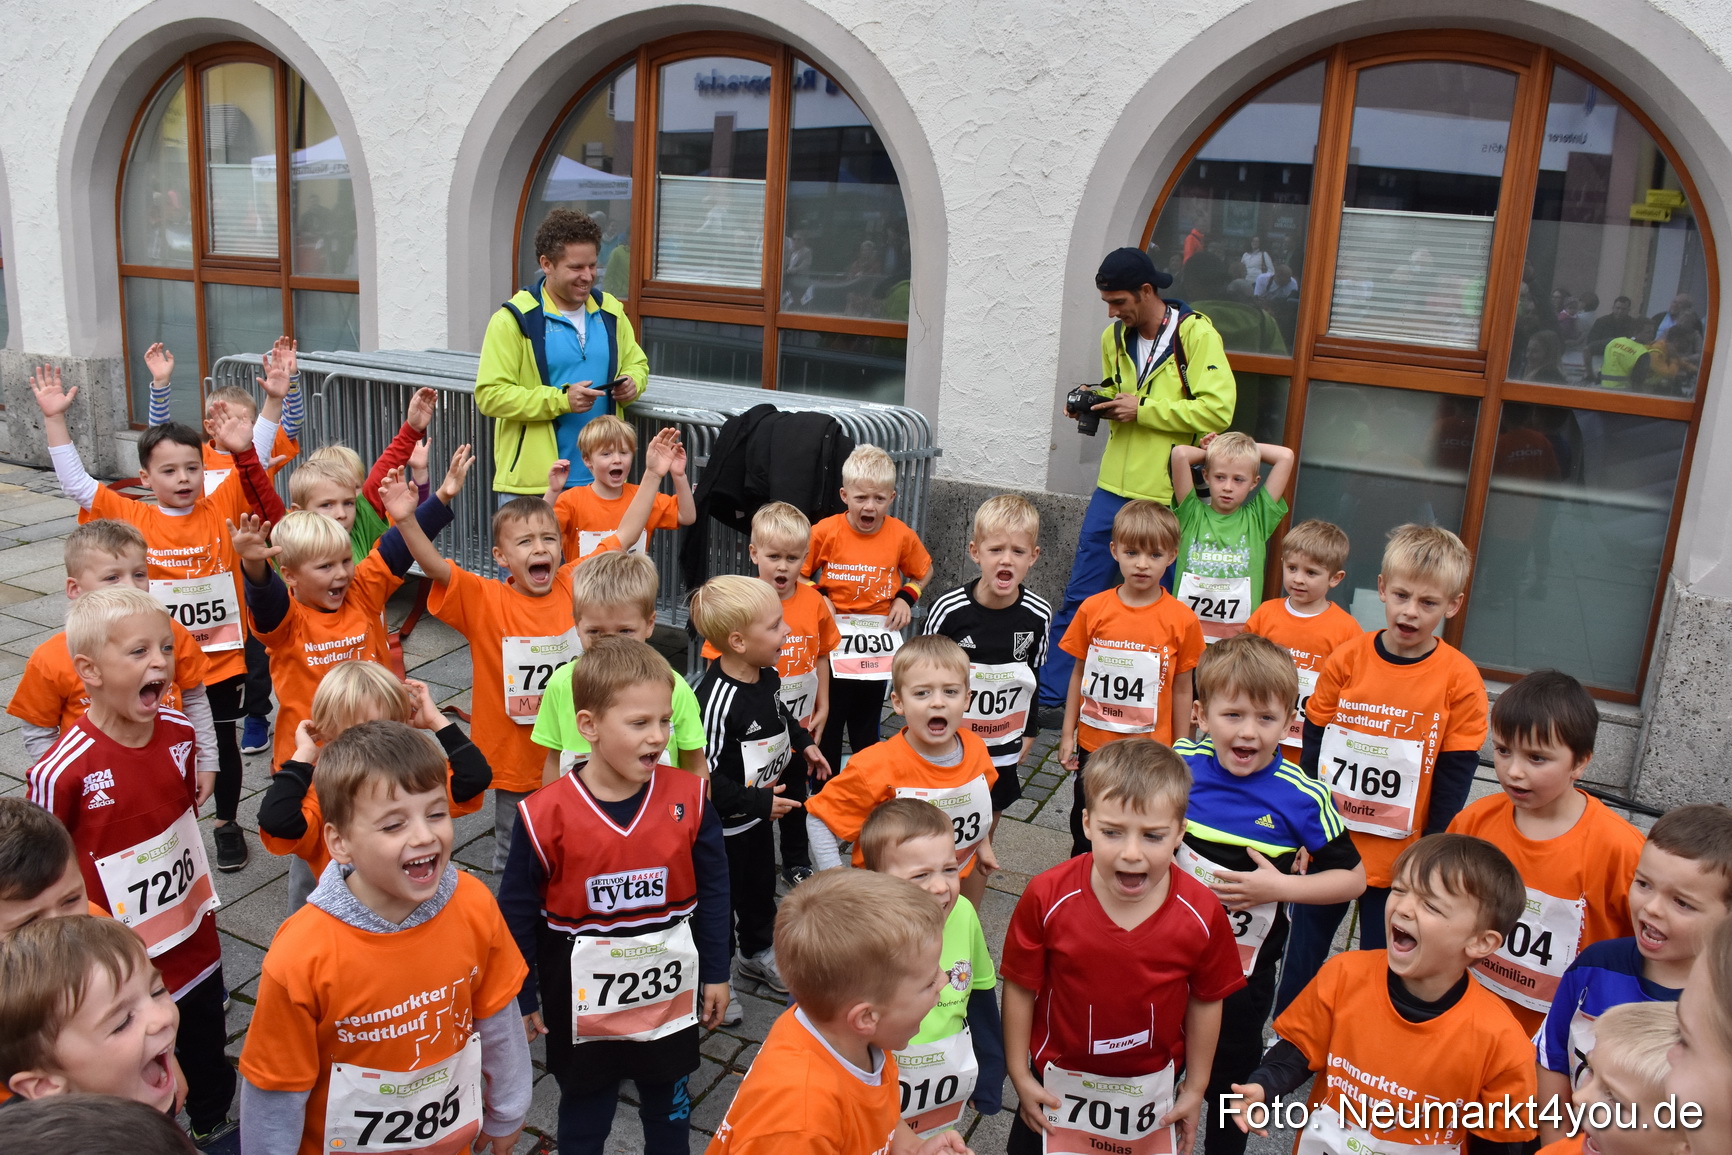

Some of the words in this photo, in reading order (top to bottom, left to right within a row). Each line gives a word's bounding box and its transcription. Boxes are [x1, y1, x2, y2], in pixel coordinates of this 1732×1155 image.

[827, 562, 877, 572] Neumarkter
[1201, 552, 1243, 564] BOCK
[827, 572, 866, 583] Stadtlauf
[166, 599, 227, 627] 7055
[1188, 595, 1241, 619] 7247
[192, 632, 209, 643] ats
[304, 633, 365, 652] Neumarkter
[841, 633, 894, 654] 7030
[1093, 637, 1146, 651] Neumarkter
[307, 648, 354, 666] Stadtlauf
[860, 661, 879, 669] Elias
[1104, 656, 1134, 666] BOCK
[985, 672, 1015, 680] BOCK
[1089, 671, 1145, 702] 7194
[786, 694, 808, 717] 77
[1102, 706, 1123, 718] Eliah
[1338, 698, 1409, 718] Neumarkter
[971, 721, 1010, 734] Benjamin
[1336, 712, 1391, 732] Stadtlauf
[1353, 741, 1389, 755] BOCK
[1424, 712, 1440, 774] BAMBINI
[1331, 756, 1401, 799] 7169
[88, 799, 115, 809] adidas
[939, 793, 971, 806] BOCK
[1343, 800, 1376, 817] Moritz
[951, 812, 981, 845] 33
[149, 832, 179, 860] BOCK
[127, 848, 195, 915] 7226
[632, 870, 664, 881] BASKET
[591, 875, 664, 910] rytas
[624, 941, 668, 957] BOCK
[1500, 921, 1553, 967] 04
[1481, 957, 1536, 989] aximilian
[592, 960, 682, 1007] 7233
[335, 985, 448, 1028] Neumarkter
[337, 1011, 428, 1044] Stadtlauf
[1109, 1038, 1134, 1049] DEHN
[898, 1052, 945, 1066] BOCK
[397, 1067, 449, 1095] BOCK
[1096, 1082, 1143, 1095] BOCK
[354, 1084, 460, 1146] 7285
[1064, 1094, 1156, 1135] 7018
[1089, 1137, 1133, 1155] Tobias
